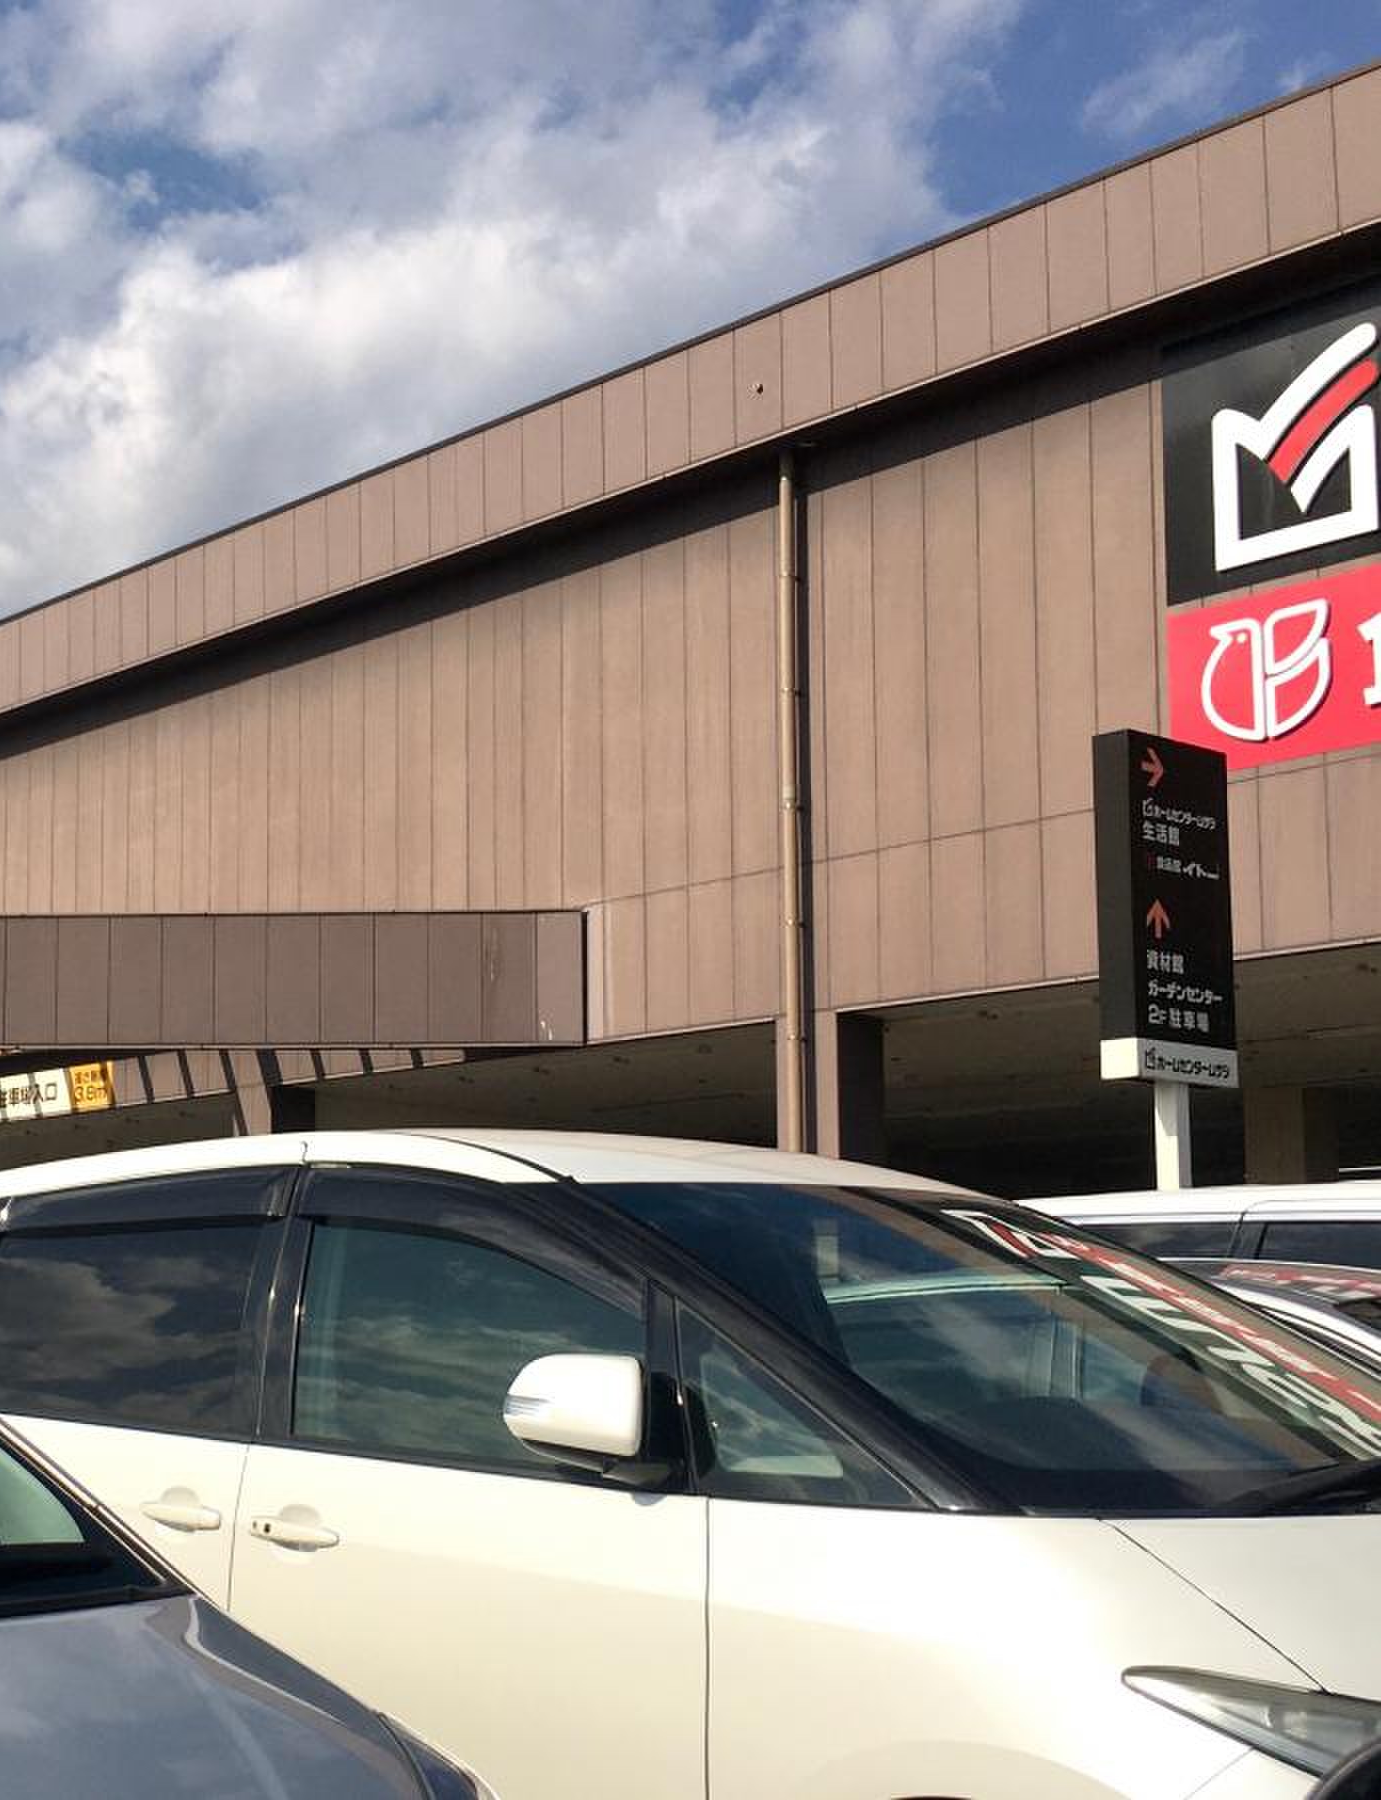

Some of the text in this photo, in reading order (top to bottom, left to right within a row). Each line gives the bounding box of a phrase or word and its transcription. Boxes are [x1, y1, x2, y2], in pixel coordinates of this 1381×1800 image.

[1142, 821, 1180, 846] 生活館
[1146, 949, 1185, 974] 資材館
[1148, 979, 1223, 1004] ガーデンセンター
